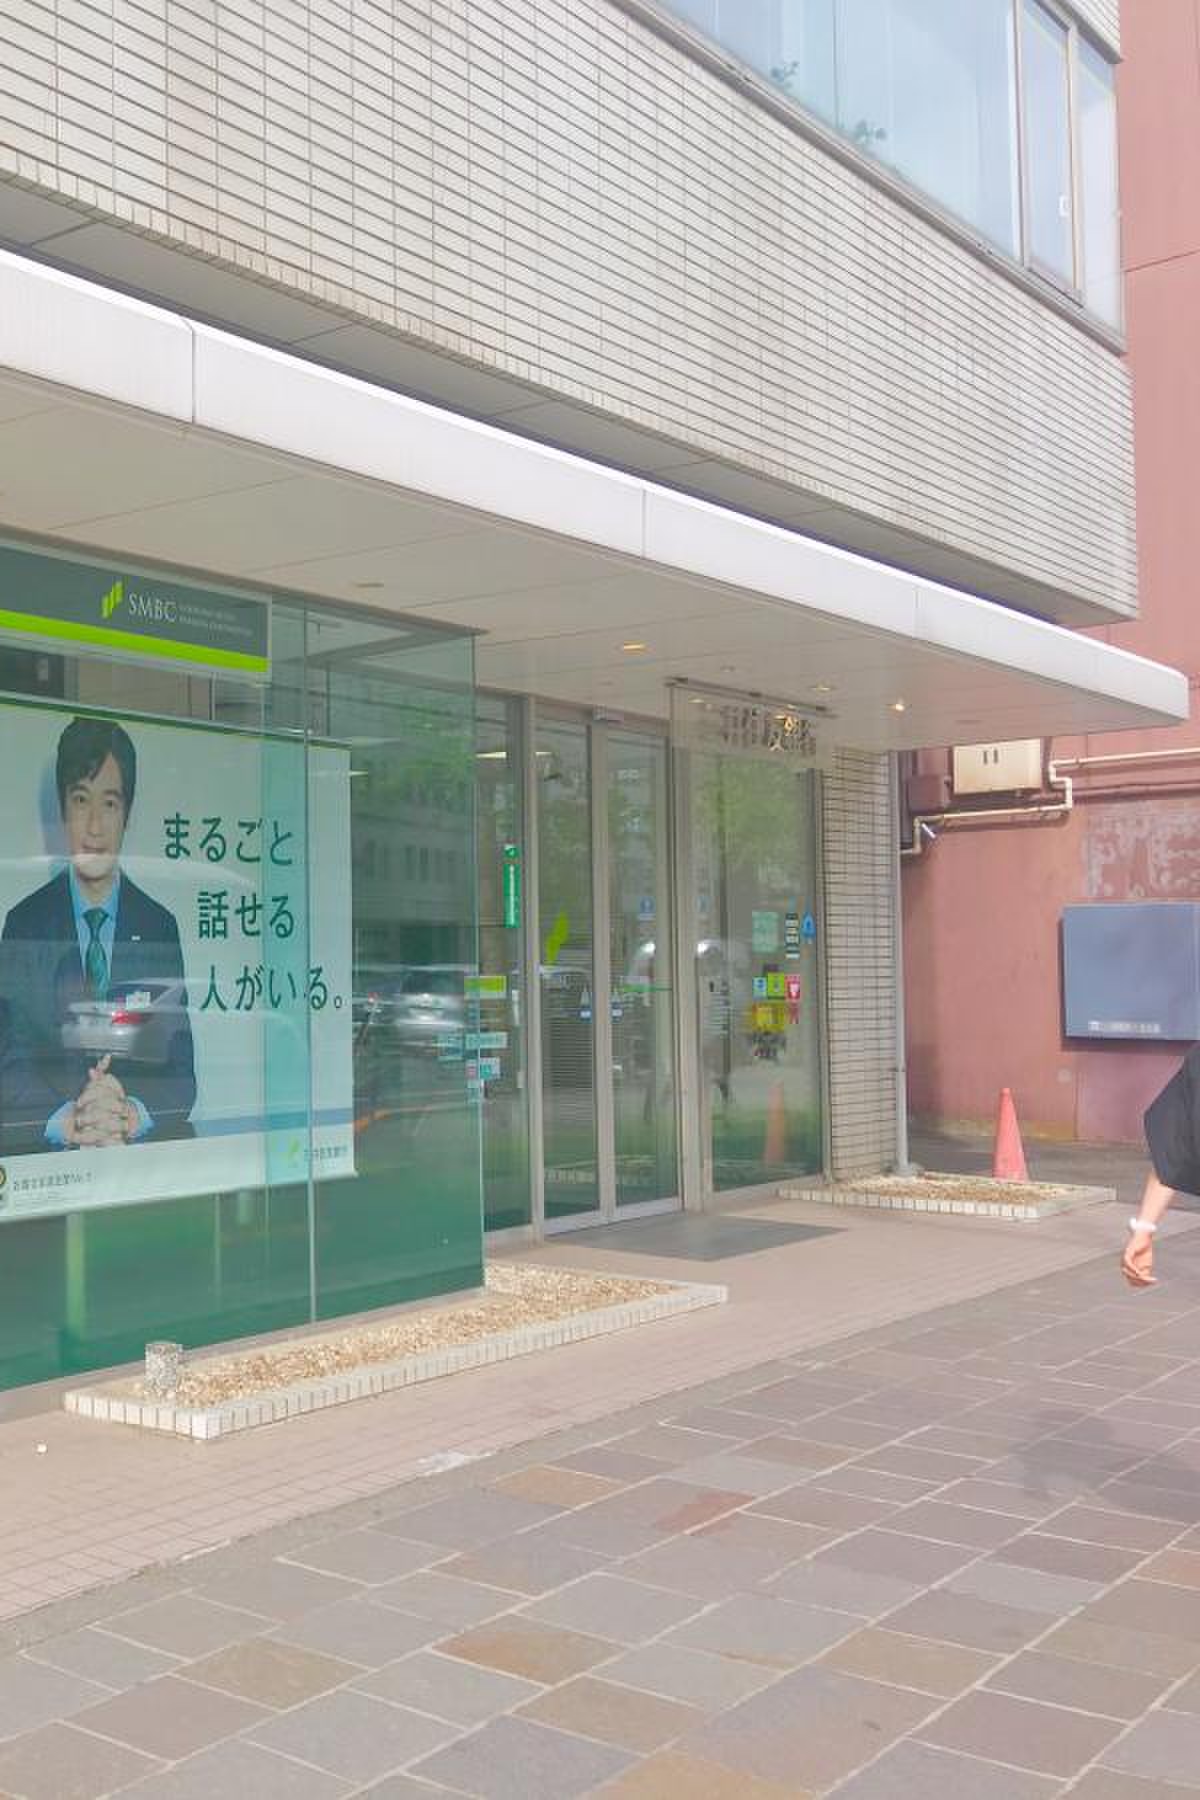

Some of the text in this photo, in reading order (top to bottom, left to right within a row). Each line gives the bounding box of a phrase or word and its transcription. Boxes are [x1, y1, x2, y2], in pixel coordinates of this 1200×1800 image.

[128, 592, 177, 623] SMBC
[163, 812, 293, 866] まるごと
[197, 889, 294, 940] 話せる
[200, 964, 344, 1012] 人がいる。
